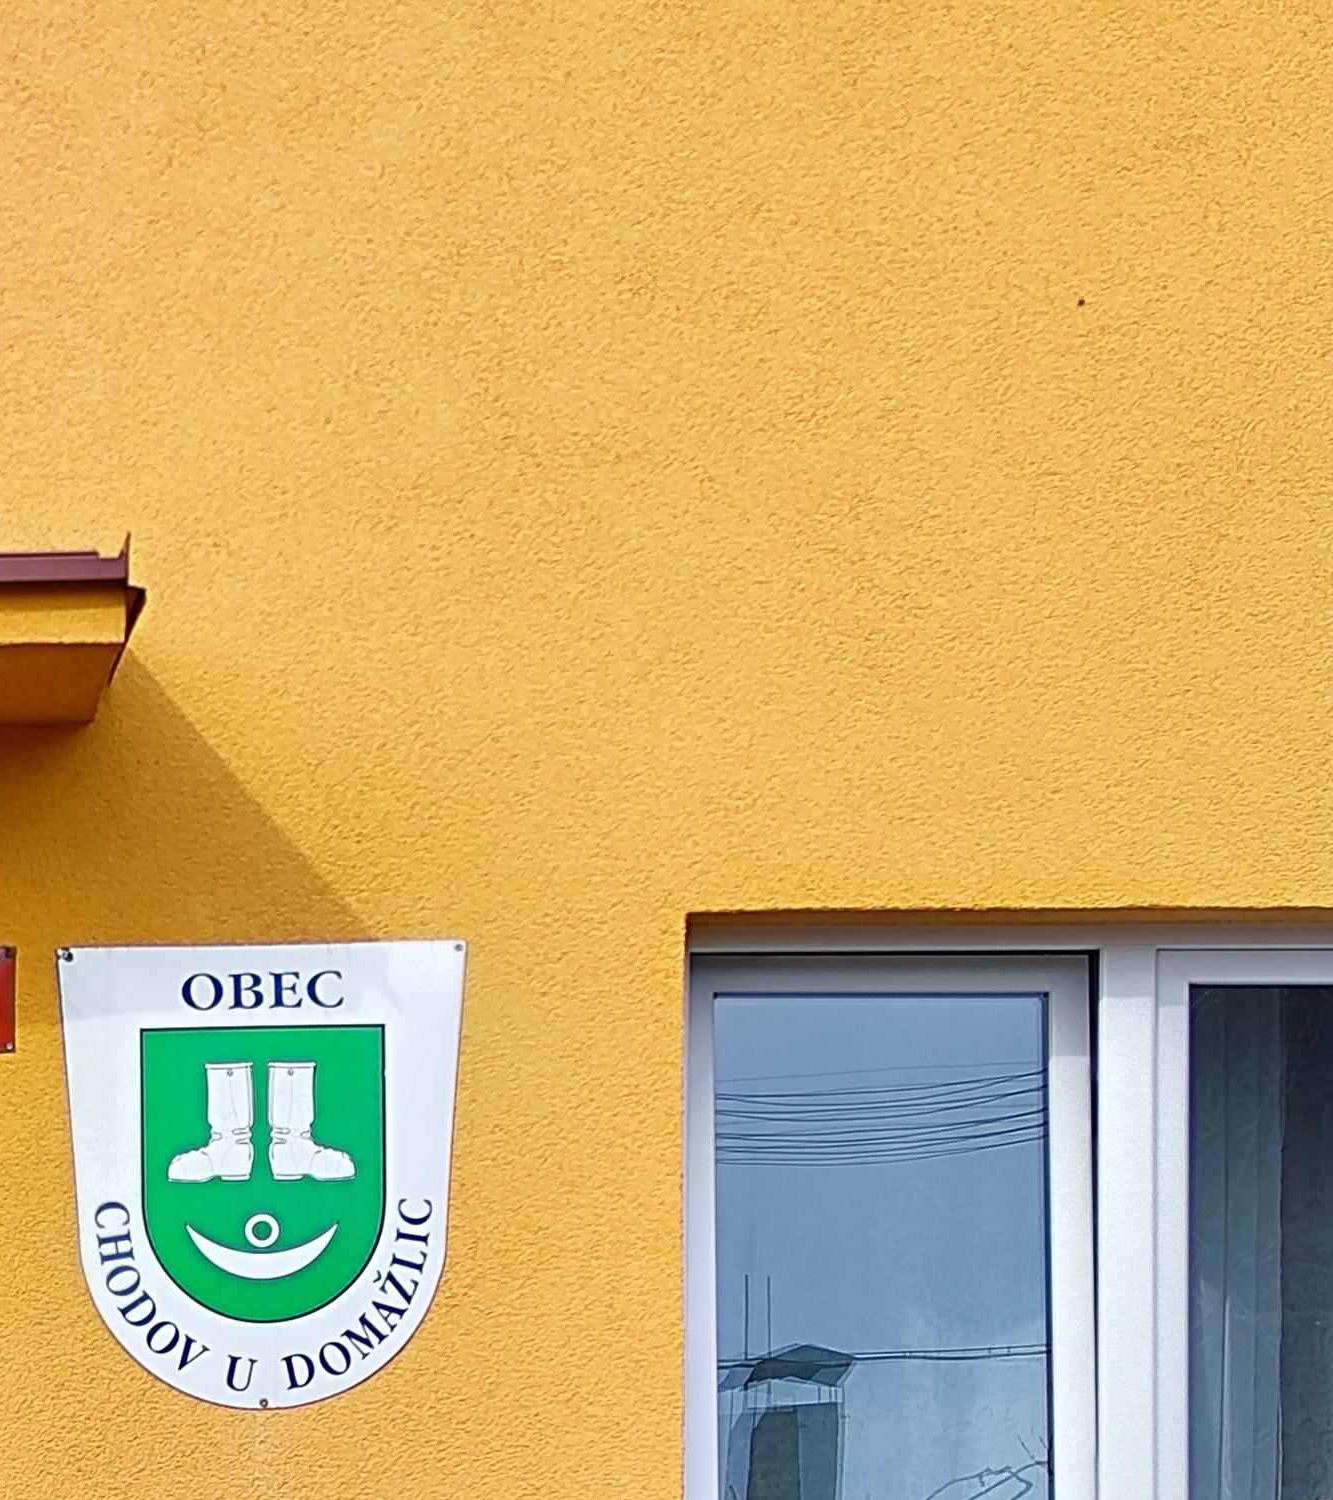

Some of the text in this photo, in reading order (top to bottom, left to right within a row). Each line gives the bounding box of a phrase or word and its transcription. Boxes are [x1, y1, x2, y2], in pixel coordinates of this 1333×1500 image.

[181, 969, 346, 1012] OBEC
[93, 1197, 434, 1392] CHODOV U DOMAŽLIC
